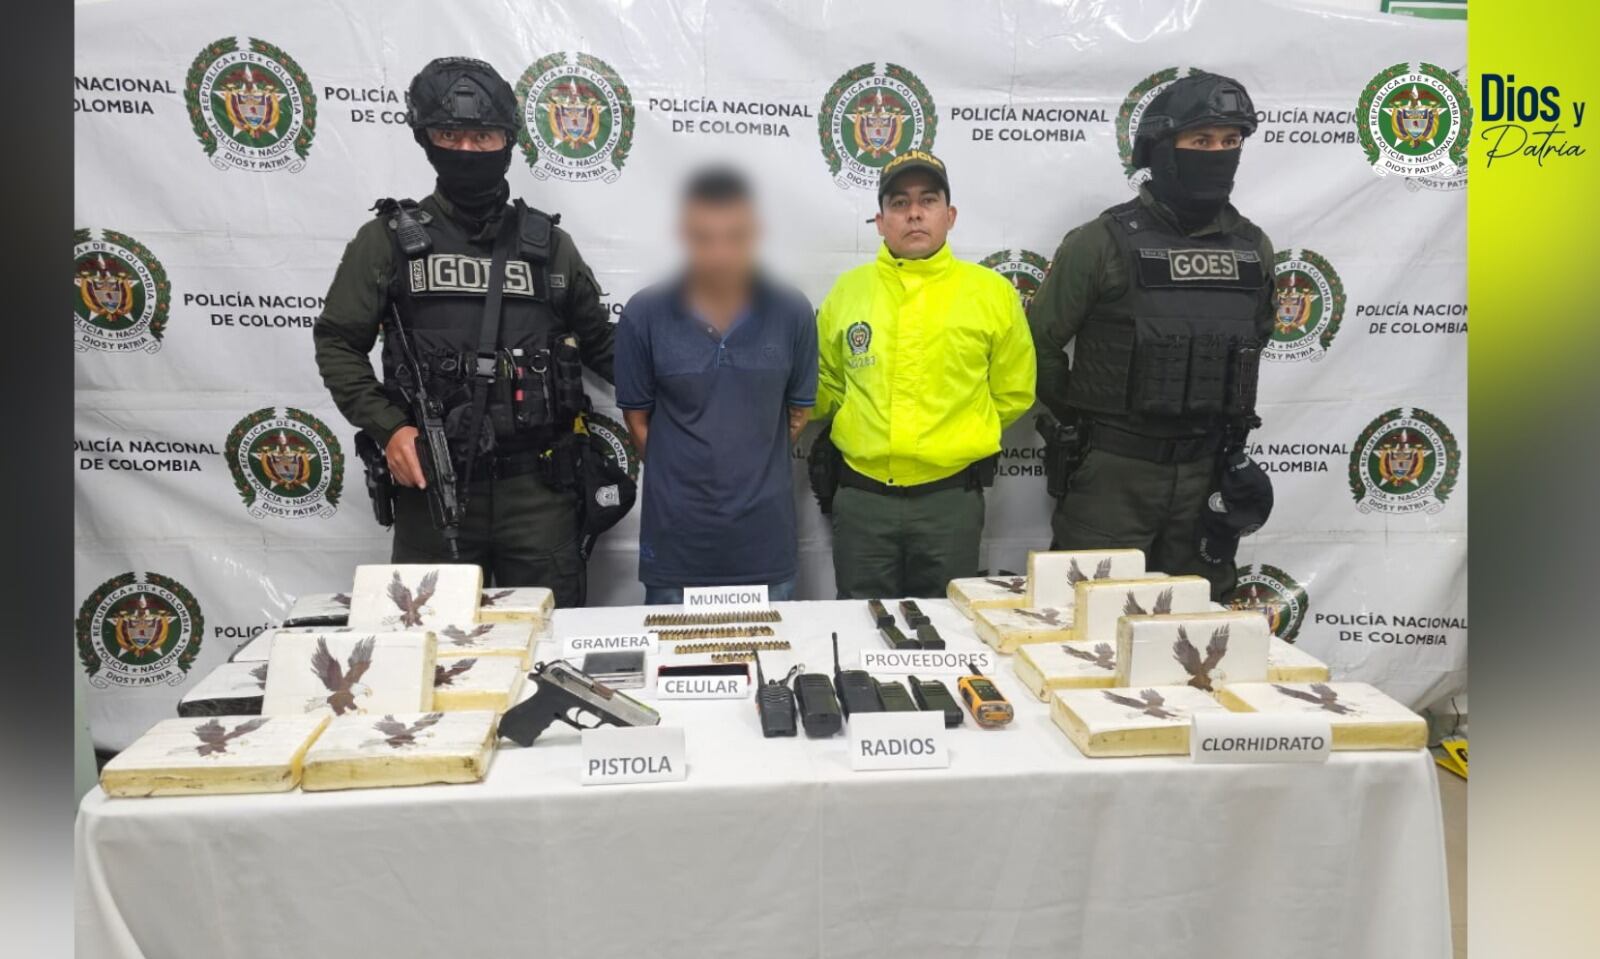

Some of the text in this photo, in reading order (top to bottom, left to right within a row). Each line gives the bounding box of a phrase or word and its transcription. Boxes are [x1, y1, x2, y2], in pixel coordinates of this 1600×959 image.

[74, 76, 176, 94] NACIONAL
[240, 52, 255, 61] DE
[265, 60, 301, 115] COLOMBIA
[324, 86, 399, 103] POLICÍA
[566, 66, 580, 74] DE
[590, 72, 620, 127] COLOMBIA
[648, 96, 813, 118] POLICÍA NACIONAL
[896, 84, 922, 135] COLOMBIA
[951, 104, 1109, 122] POLICÍA NACIONAL
[351, 109, 375, 123] DE
[672, 120, 790, 137] DE COLOMBIA
[972, 128, 1086, 142] DE COLOMBIA
[1264, 130, 1285, 143] DE
[260, 155, 291, 169] PATRIA
[575, 166, 607, 179] PATRIA
[92, 243, 155, 300] DE COLOMBIA
[1174, 254, 1233, 275] GOES
[1308, 267, 1331, 312] COLOMBIA
[184, 292, 255, 308] POLICÍA
[1356, 301, 1409, 317] POLICÍA
[210, 314, 318, 328] DE COLOMB
[1369, 322, 1468, 334] DE COLOMBIA
[117, 337, 148, 350] PATRIA
[1285, 347, 1315, 359] PATRIA
[129, 441, 220, 455] NACIONAL
[300, 425, 330, 472] COLOMBIA
[1268, 444, 1348, 455] NACIONAL
[1420, 424, 1444, 467] COLOMBIA
[80, 458, 202, 471] DE COLOMBIA
[293, 504, 323, 516] PATRIA
[1397, 500, 1430, 511] PATRIA
[689, 592, 761, 605] MUNICION
[159, 589, 189, 634] COLOMBIA
[1315, 612, 1468, 629] POLICÍA NACIONAL
[571, 636, 650, 650] GRAMERA
[1339, 631, 1447, 645] DE COLOMBIA
[865, 653, 989, 667] PROVEEDORES
[139, 670, 173, 684] PATRIA
[665, 680, 738, 694] CELULAR
[861, 738, 936, 756] RADIOS
[1202, 736, 1324, 752] CLORHIDRATO
[588, 756, 672, 776] PISTOLA
